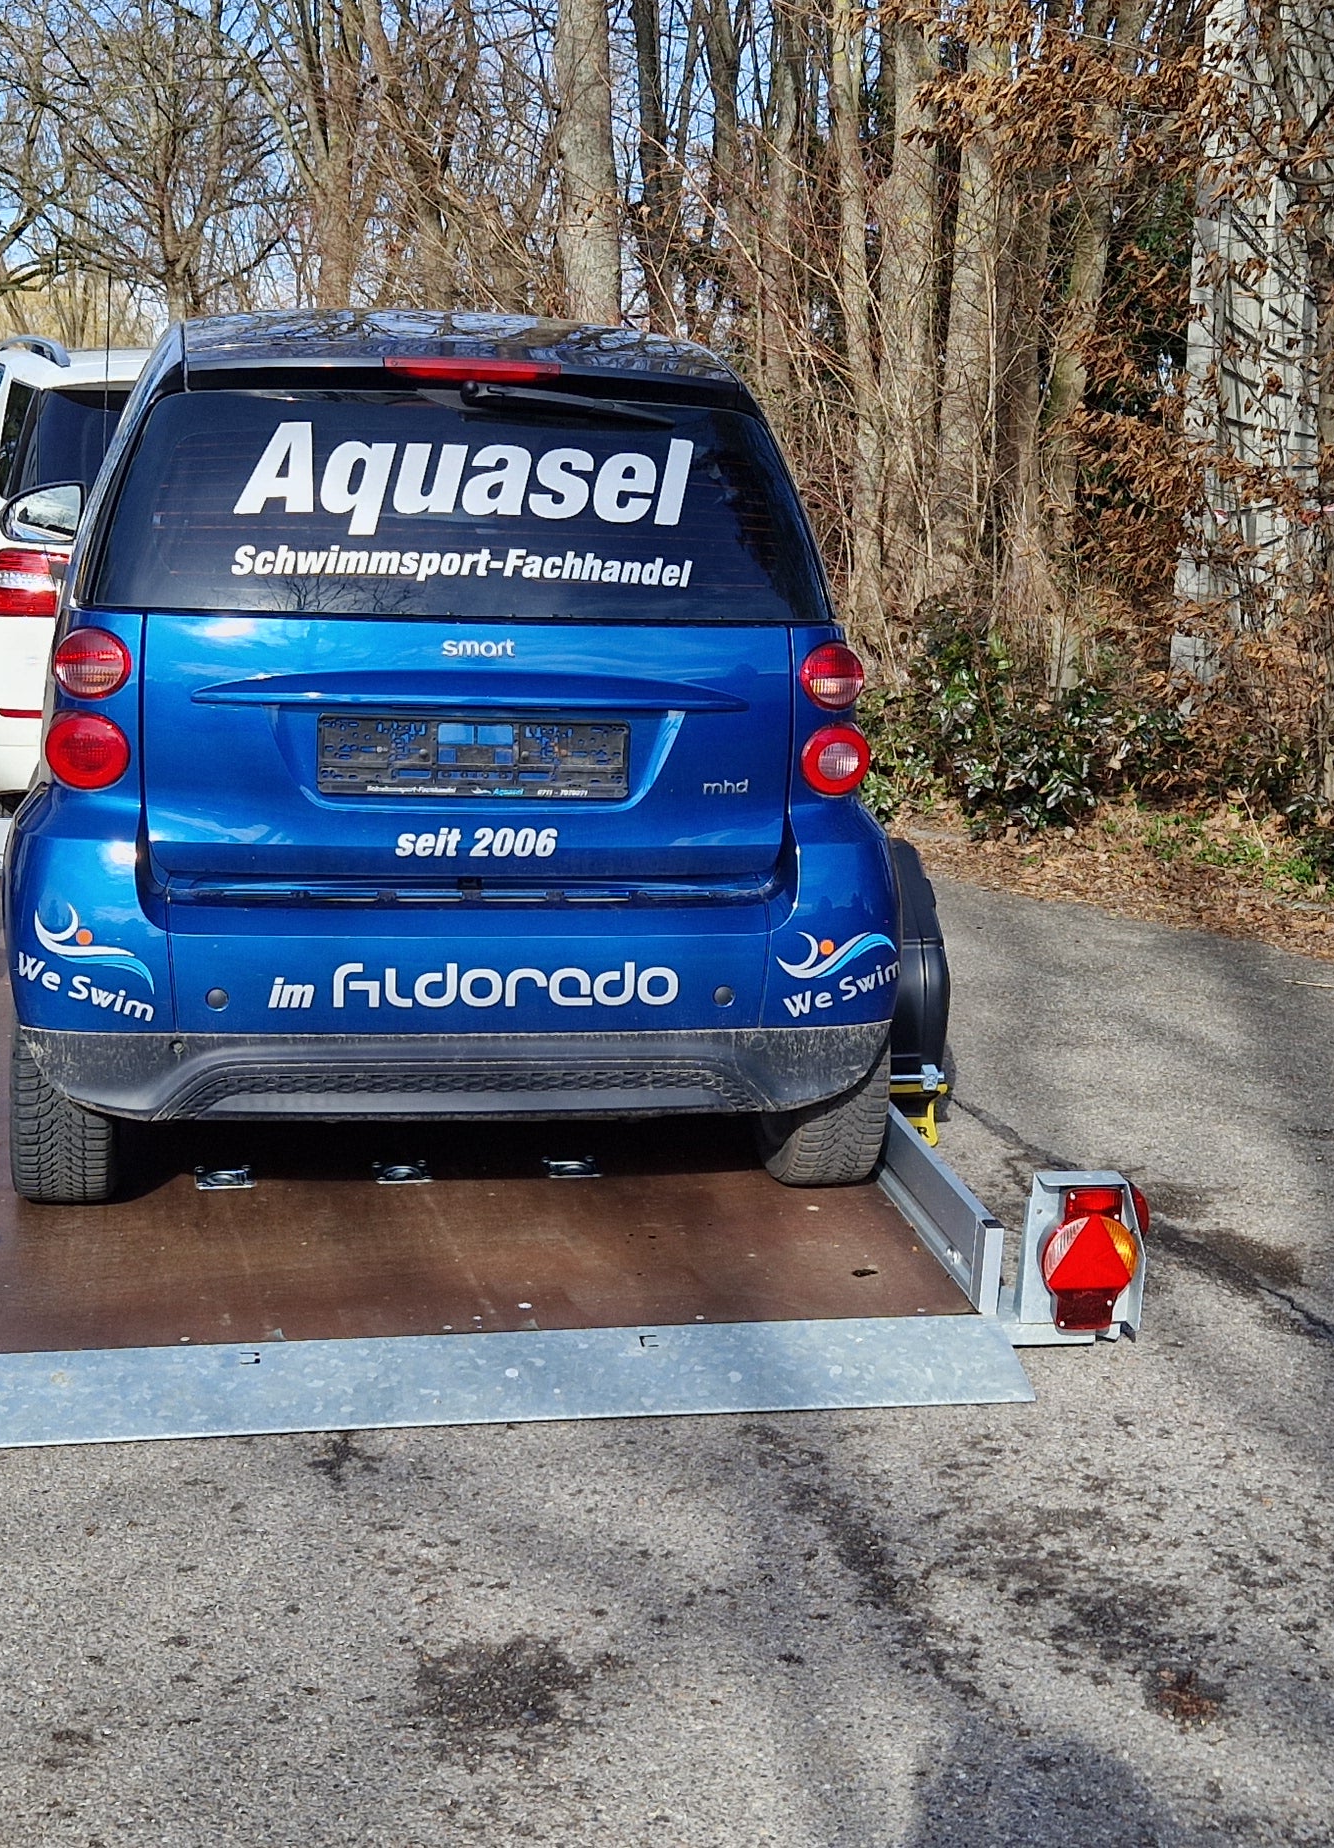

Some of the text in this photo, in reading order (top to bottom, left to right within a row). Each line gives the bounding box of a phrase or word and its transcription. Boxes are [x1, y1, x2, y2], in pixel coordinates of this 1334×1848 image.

[233, 421, 694, 536] Aquasel
[231, 544, 693, 588] Schwimmsport-Fachhandel
[441, 638, 516, 658] smart
[703, 779, 748, 795] mhd
[396, 827, 558, 857] seit 2006
[19, 951, 155, 1022] We Swim
[268, 977, 315, 1008] im
[783, 960, 901, 1018] We Swim
